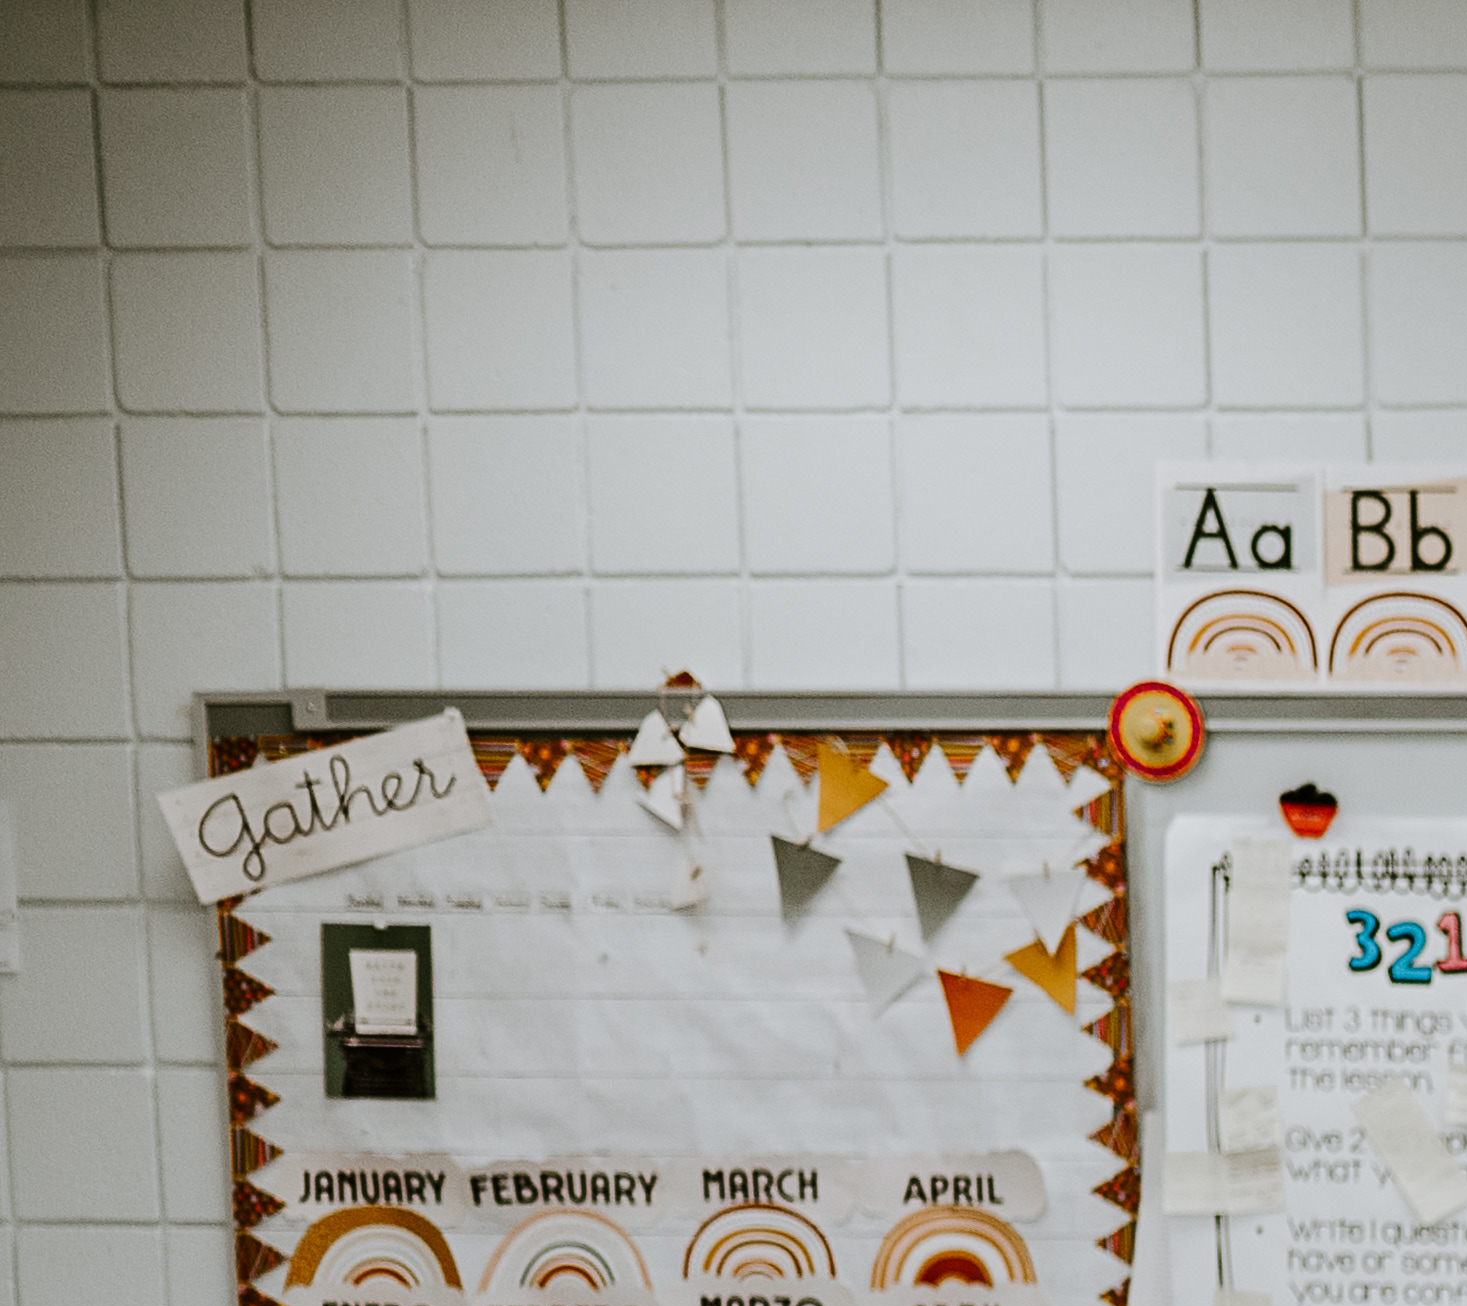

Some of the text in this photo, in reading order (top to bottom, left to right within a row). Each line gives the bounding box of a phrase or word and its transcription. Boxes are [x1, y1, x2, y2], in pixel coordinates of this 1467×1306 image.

[1183, 487, 1294, 571] Aa
[1350, 489, 1453, 572] Bb
[299, 1170, 447, 1205] JANUARY
[469, 1171, 658, 1206] FEBRUARY
[702, 1167, 819, 1204] MARCH
[903, 1174, 1005, 1206] APRIL
